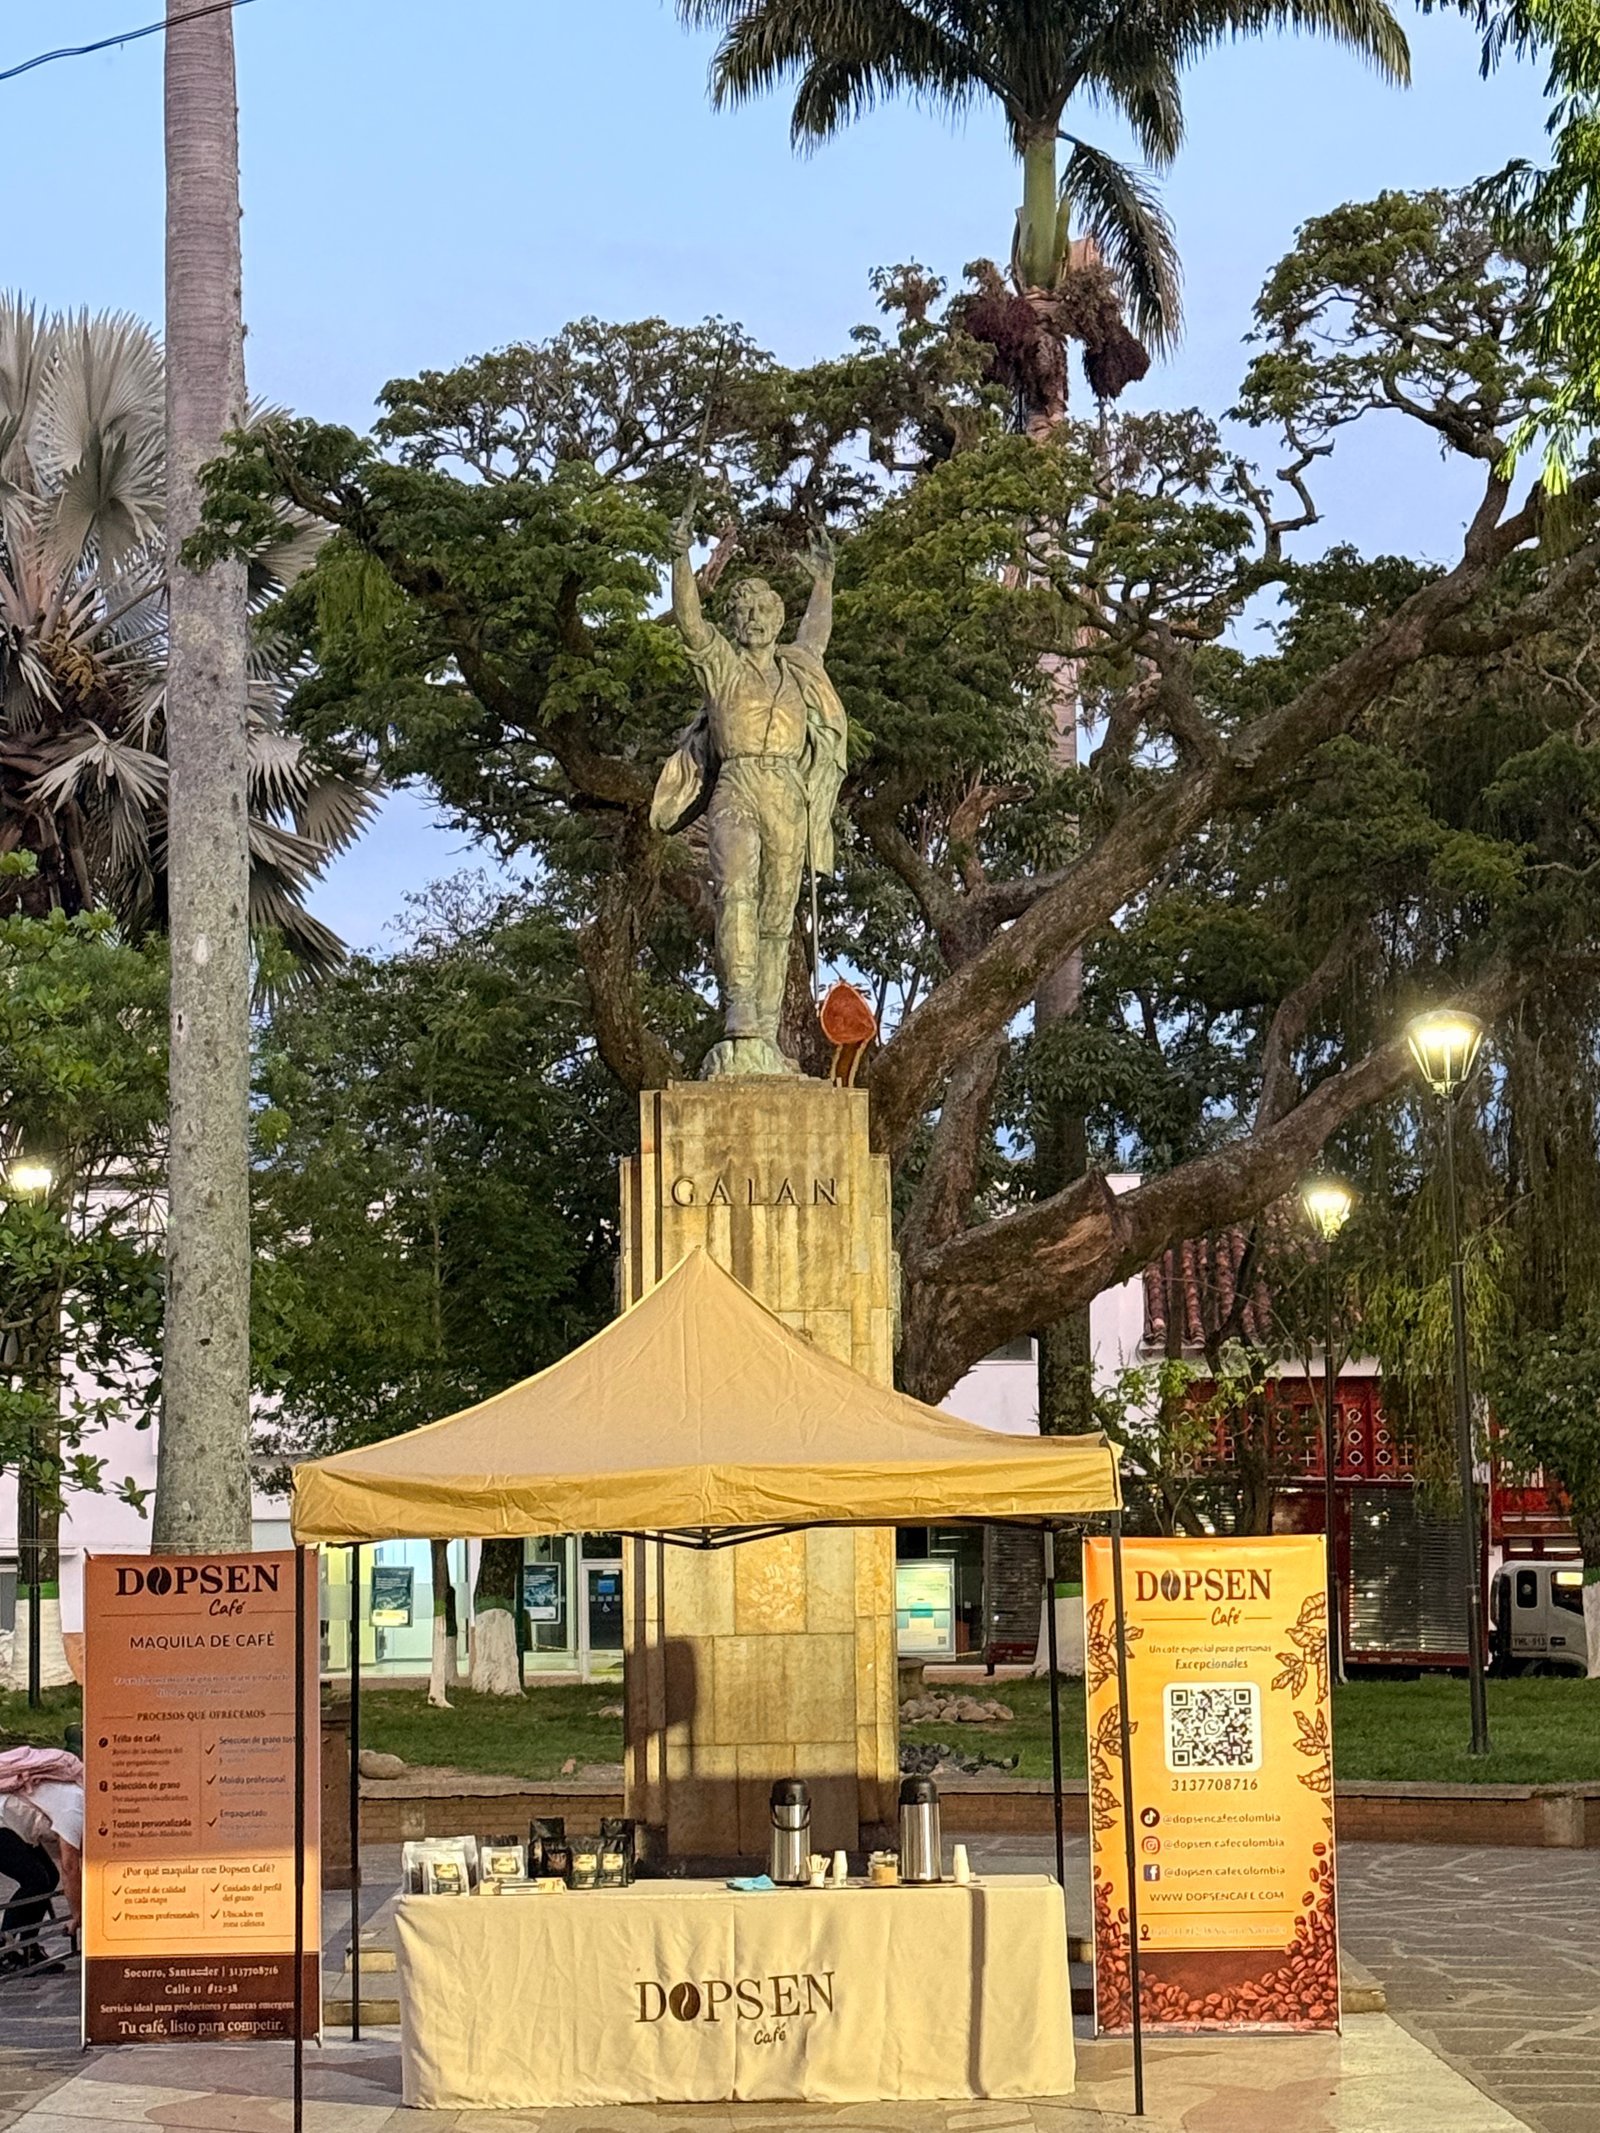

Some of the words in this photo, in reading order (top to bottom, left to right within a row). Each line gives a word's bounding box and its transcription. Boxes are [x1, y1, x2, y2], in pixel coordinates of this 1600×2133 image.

[671, 1174, 838, 1207] GALAN
[115, 1564, 281, 1596] DOPSEN
[1135, 1568, 1272, 1602] DOPSEN
[208, 1598, 246, 1617] Café
[1211, 1606, 1241, 1627] Café
[130, 1635, 205, 1650] MAQUILA
[210, 1634, 230, 1648] DE
[235, 1631, 275, 1647] CAFÉ
[1175, 1658, 1248, 1672] Excepcionales
[137, 1711, 185, 1722] PROCESOS
[187, 1710, 206, 1723] QUE
[208, 1708, 267, 1720] OFRECEMOS
[148, 1780, 158, 1790] de
[1171, 1778, 1258, 1792] 3137708716
[143, 1866, 160, 1879] qué
[219, 1864, 251, 1877] Dopsen
[123, 1967, 166, 1978] Socorro,
[168, 1966, 219, 1977] Santander
[165, 1983, 191, 1994] Calle
[634, 1970, 836, 2024] DOPSEN
[100, 2003, 132, 2014] Servicio
[134, 2002, 153, 2013] ideal
[154, 2004, 173, 2014] para
[229, 2002, 257, 2011] marcas
[118, 2020, 137, 2035] Tu
[138, 2018, 168, 2035] café,
[170, 2018, 196, 2033] listo
[197, 2020, 225, 2036] para
[227, 2018, 284, 2035] competir.
[753, 2022, 787, 2045] Café
